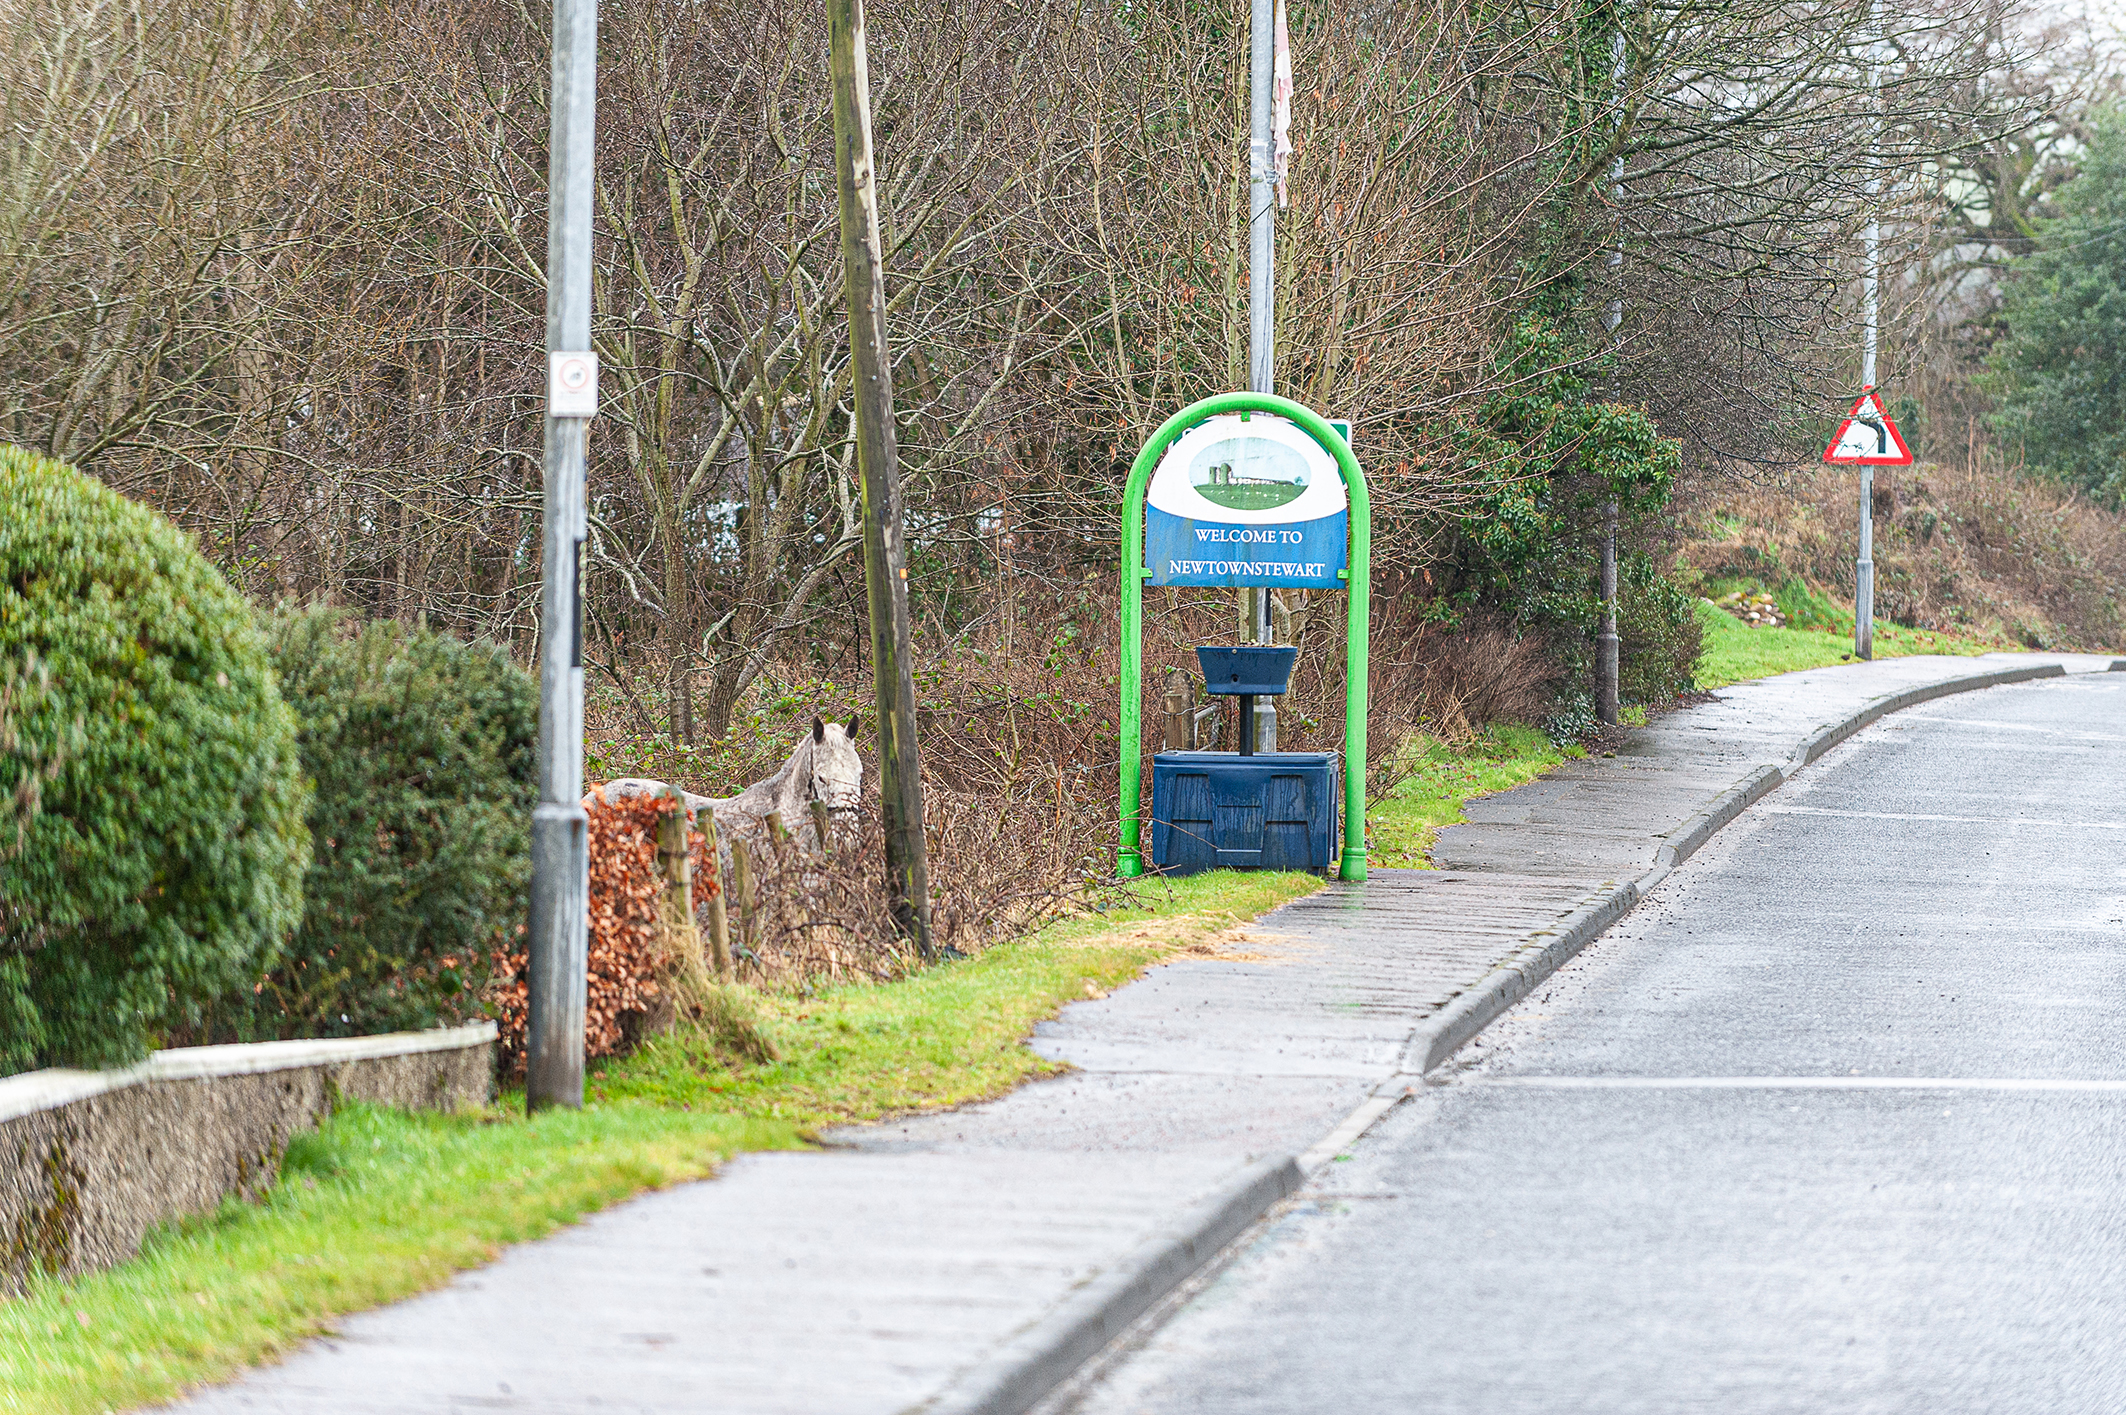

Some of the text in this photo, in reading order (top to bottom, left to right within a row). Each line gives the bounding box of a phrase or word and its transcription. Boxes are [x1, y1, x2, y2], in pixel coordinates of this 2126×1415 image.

[1195, 528, 1303, 544] WELCOME TO
[1169, 560, 1325, 577] NEWTOWNSTEWART
